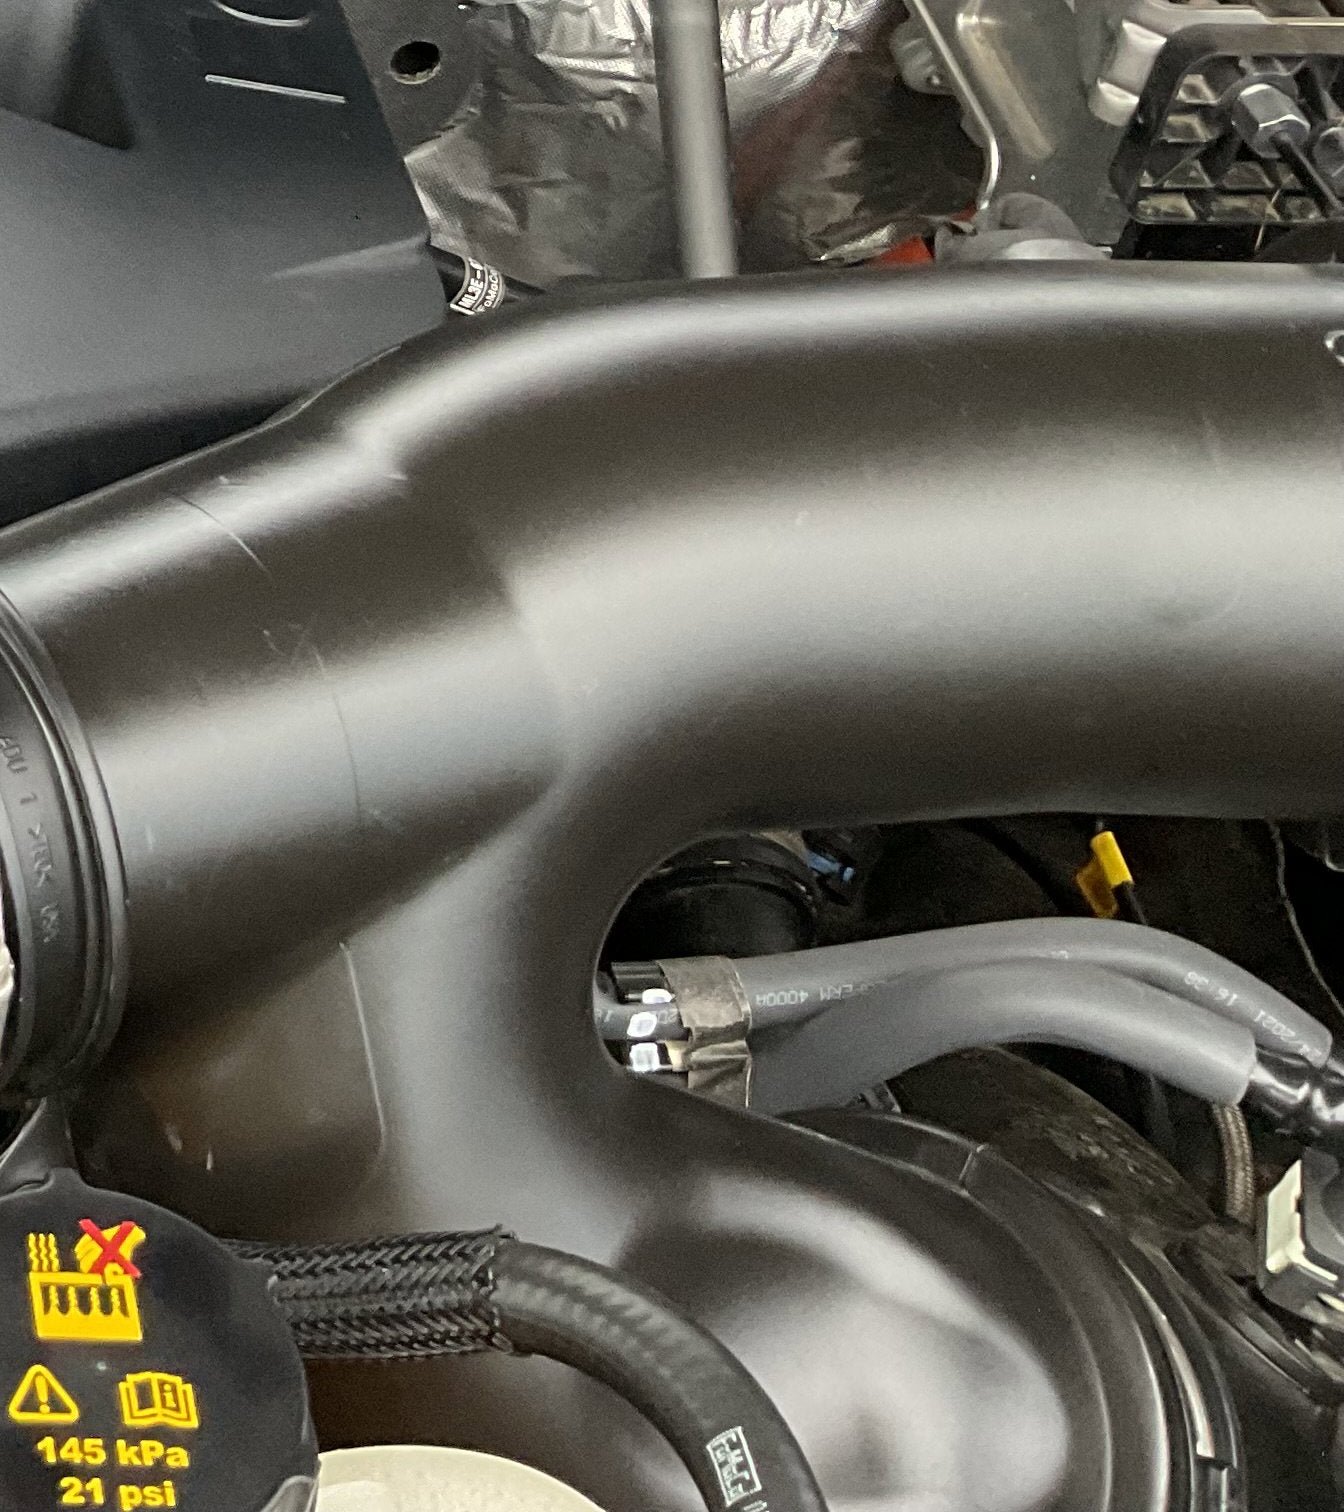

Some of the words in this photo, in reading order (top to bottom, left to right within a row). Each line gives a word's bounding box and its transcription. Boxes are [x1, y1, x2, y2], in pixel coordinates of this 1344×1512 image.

[37, 1436, 107, 1465] 145
[116, 1439, 190, 1468] kPa
[60, 1476, 105, 1505] 21
[119, 1480, 177, 1511] psi
